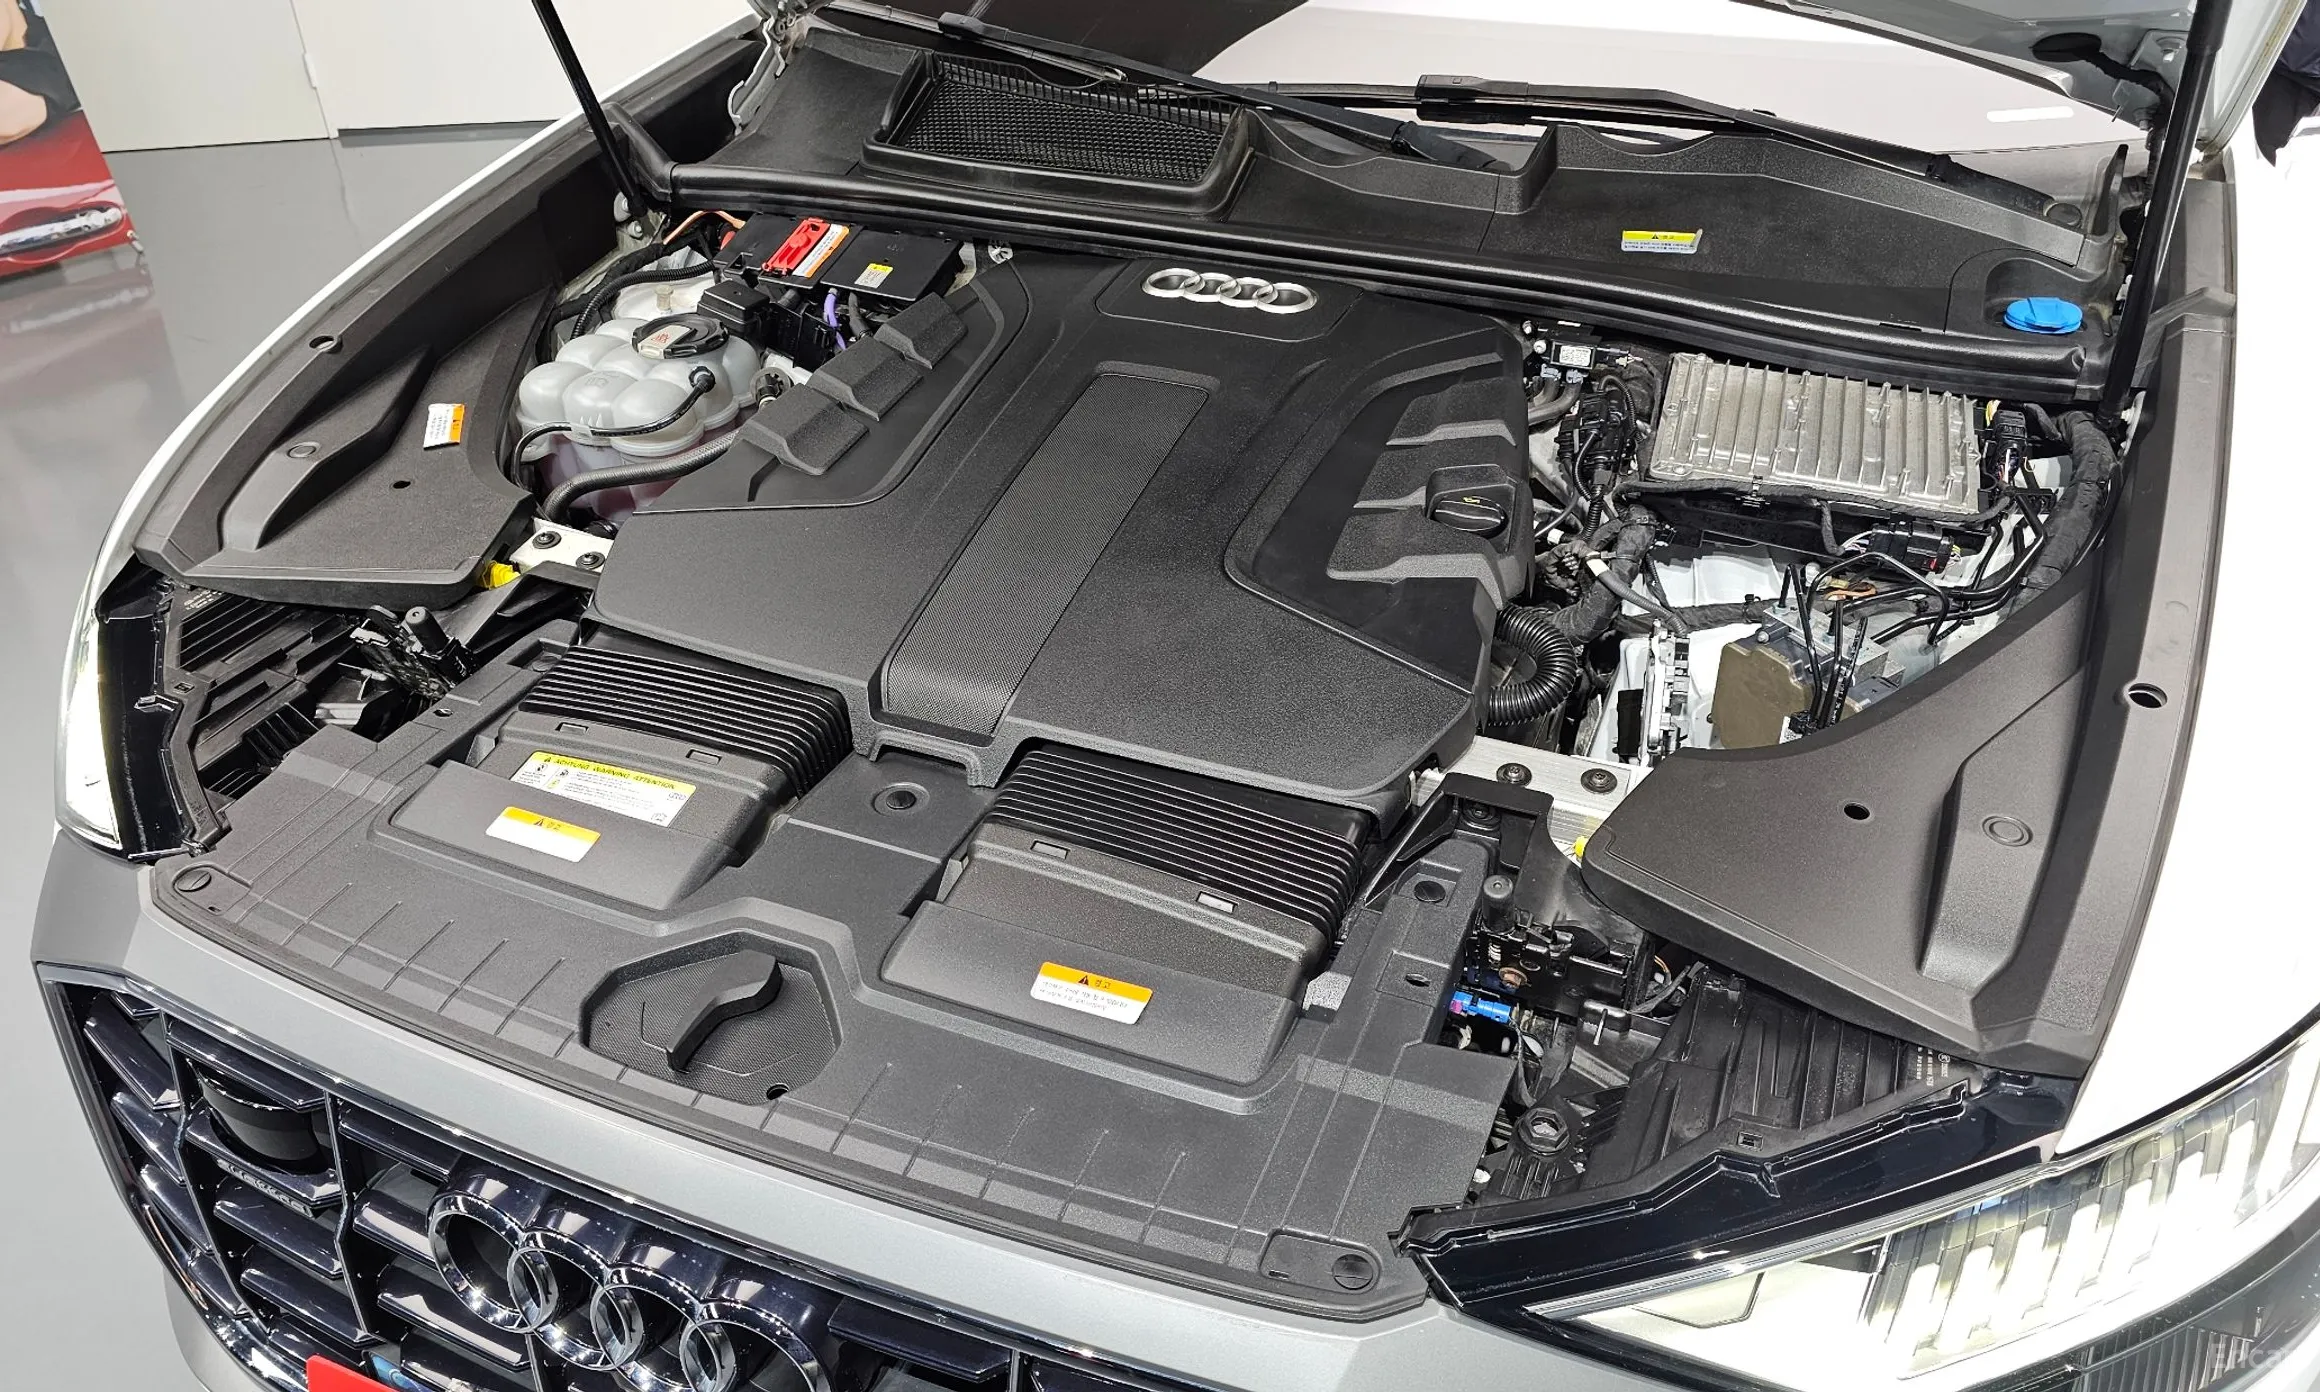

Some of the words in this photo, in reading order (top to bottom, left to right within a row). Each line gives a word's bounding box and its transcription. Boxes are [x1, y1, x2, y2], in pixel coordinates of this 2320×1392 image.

[553, 758, 590, 770] ACHTUNG
[593, 766, 631, 780] WARNING
[633, 775, 676, 790] ATTENTION
